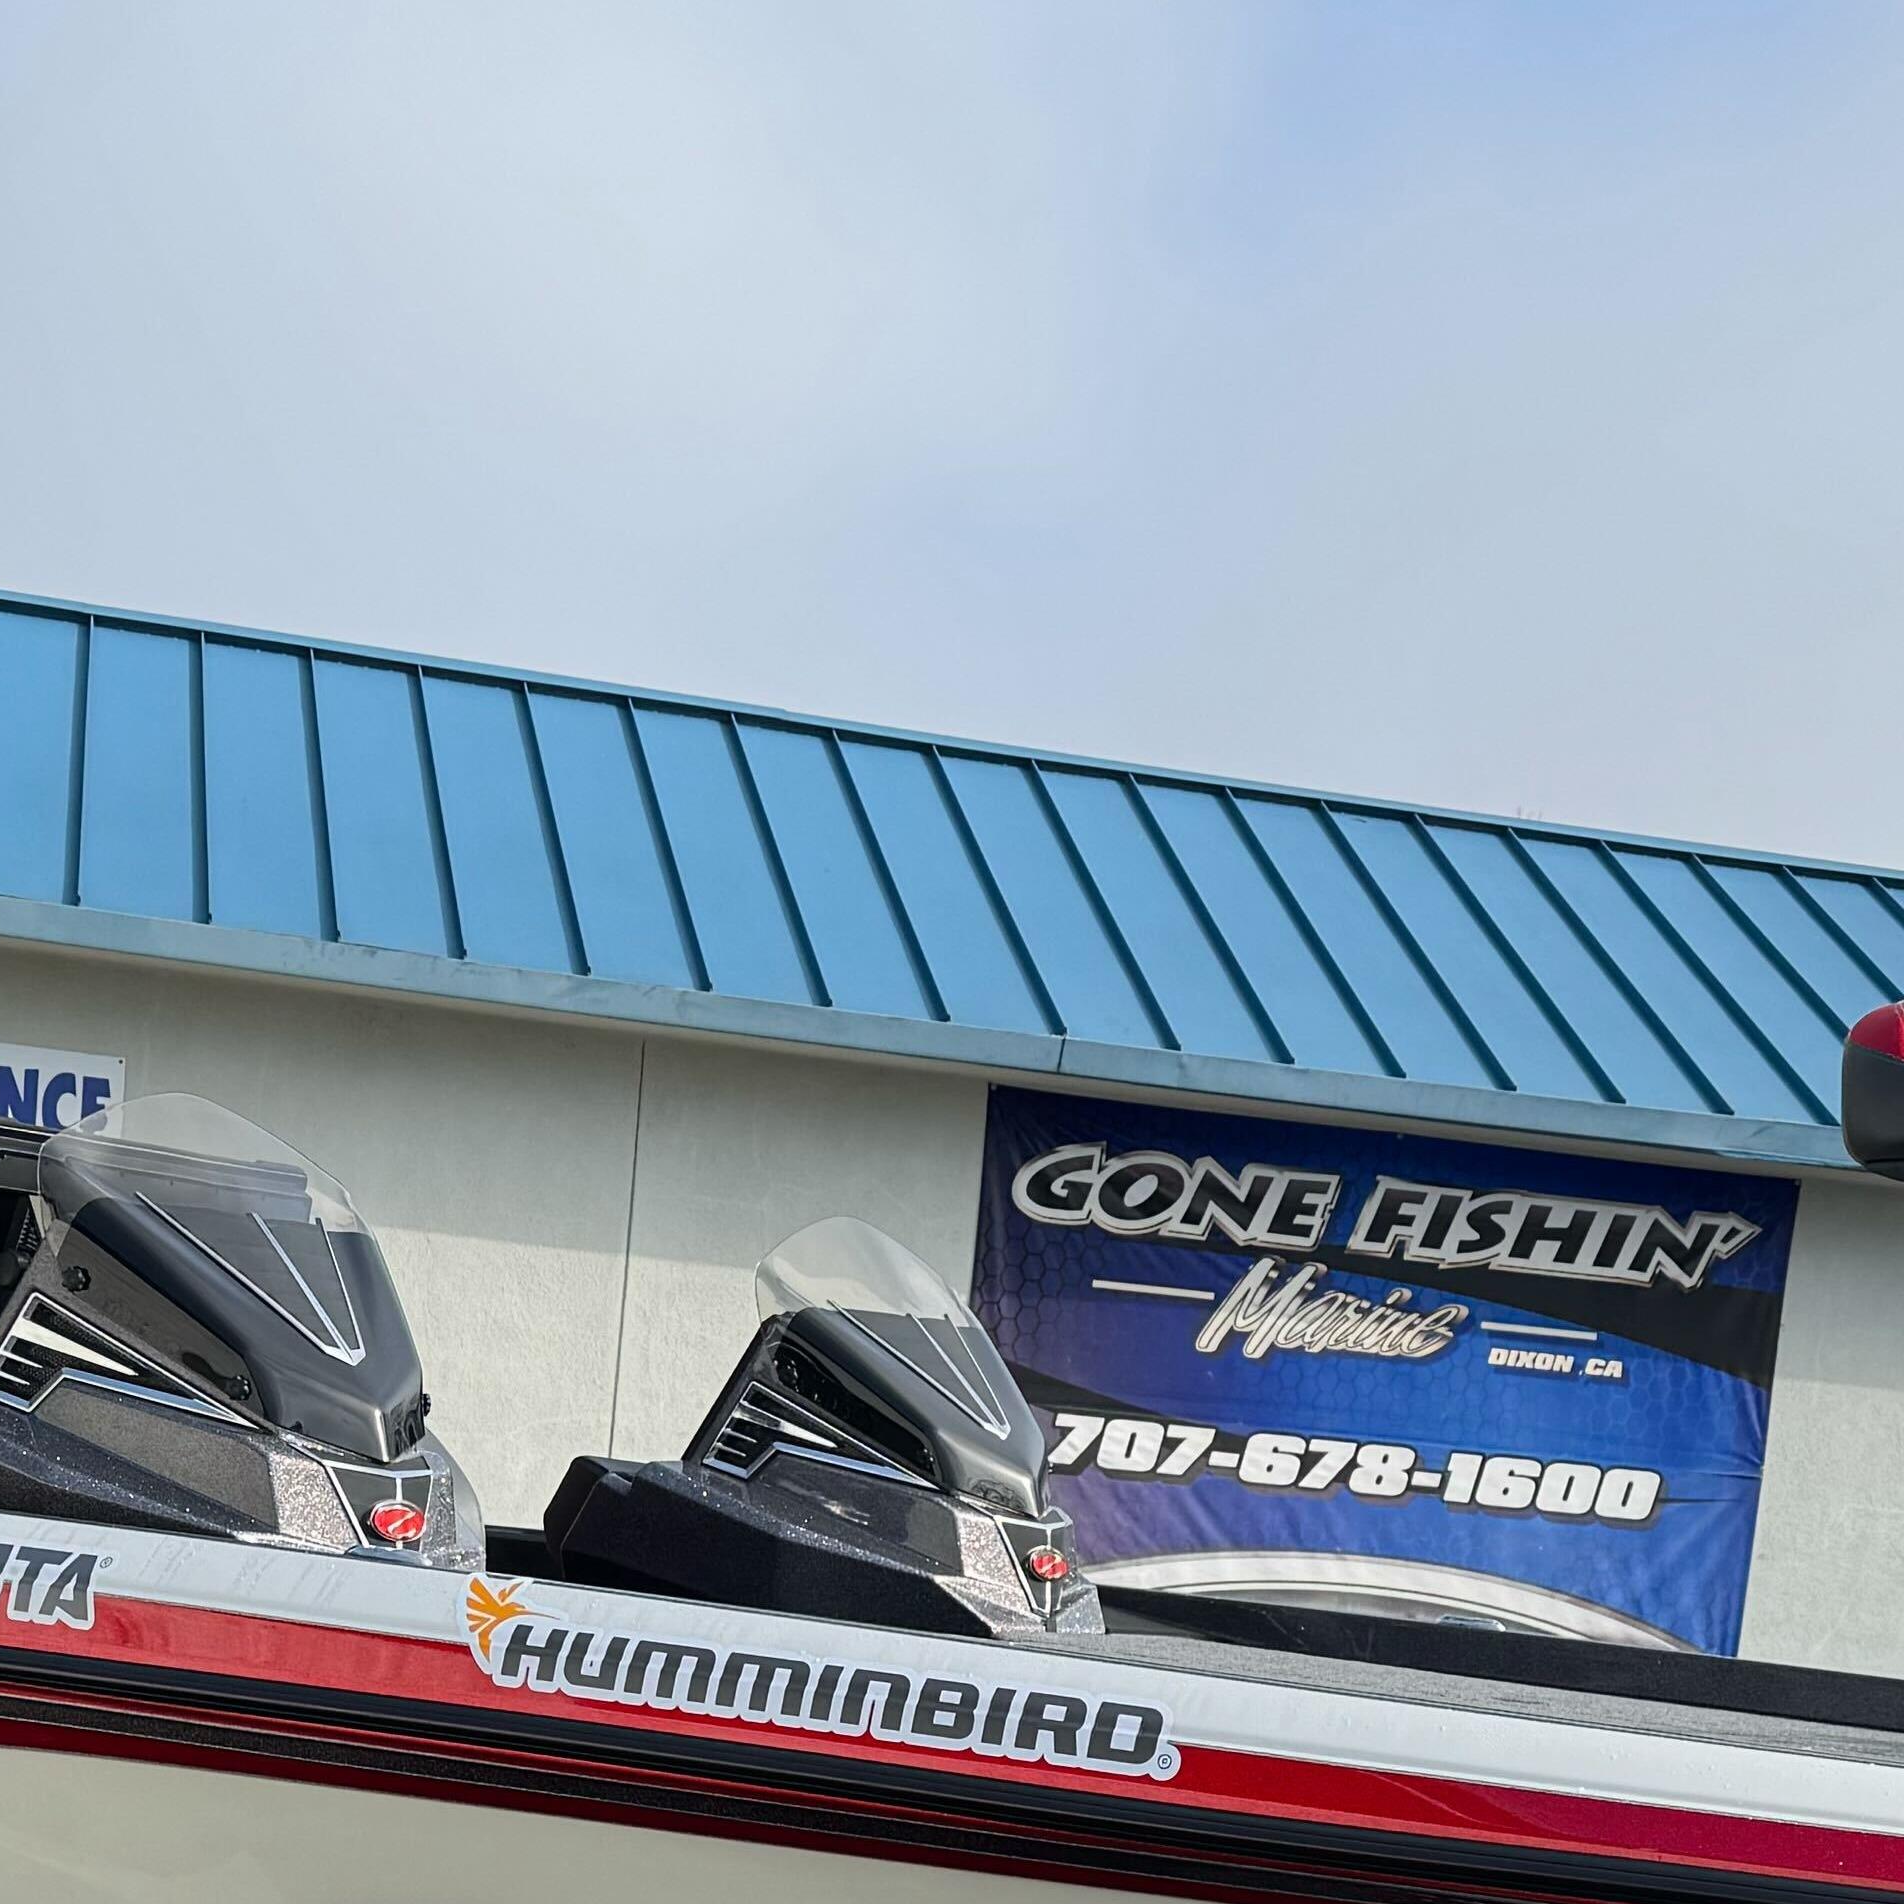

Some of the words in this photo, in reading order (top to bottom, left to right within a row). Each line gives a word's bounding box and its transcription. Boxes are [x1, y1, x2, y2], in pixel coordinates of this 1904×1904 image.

[1017, 1145, 1338, 1248] GONE
[1350, 1177, 1759, 1287] FISHIN'
[1196, 1256, 1468, 1361] Marine
[1488, 1348, 1574, 1373] DIXON
[1049, 1413, 1661, 1520] 707-678-1600
[499, 1623, 1166, 1765] HUMMINBIRD
